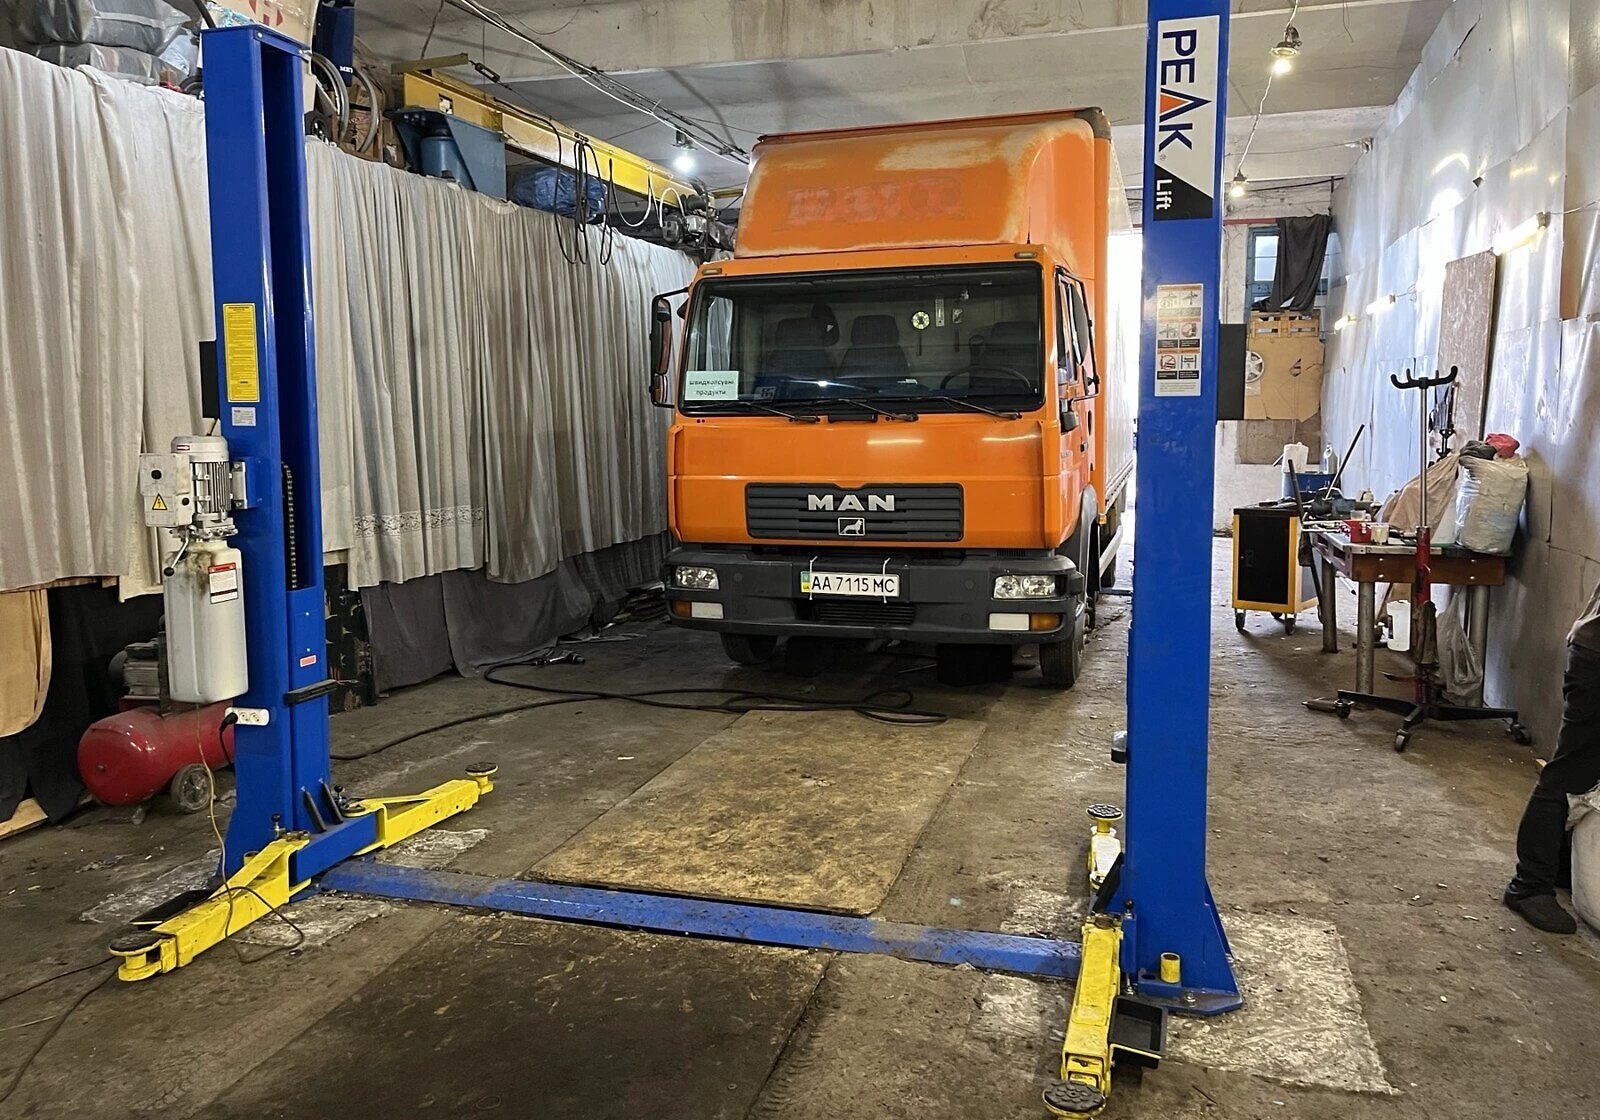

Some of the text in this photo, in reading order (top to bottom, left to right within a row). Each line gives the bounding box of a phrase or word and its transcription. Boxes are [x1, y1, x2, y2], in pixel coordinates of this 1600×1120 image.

[1156, 29, 1212, 210] PEAK Lift
[807, 494, 895, 511] MAN
[811, 576, 895, 593] AA 7115 MC
